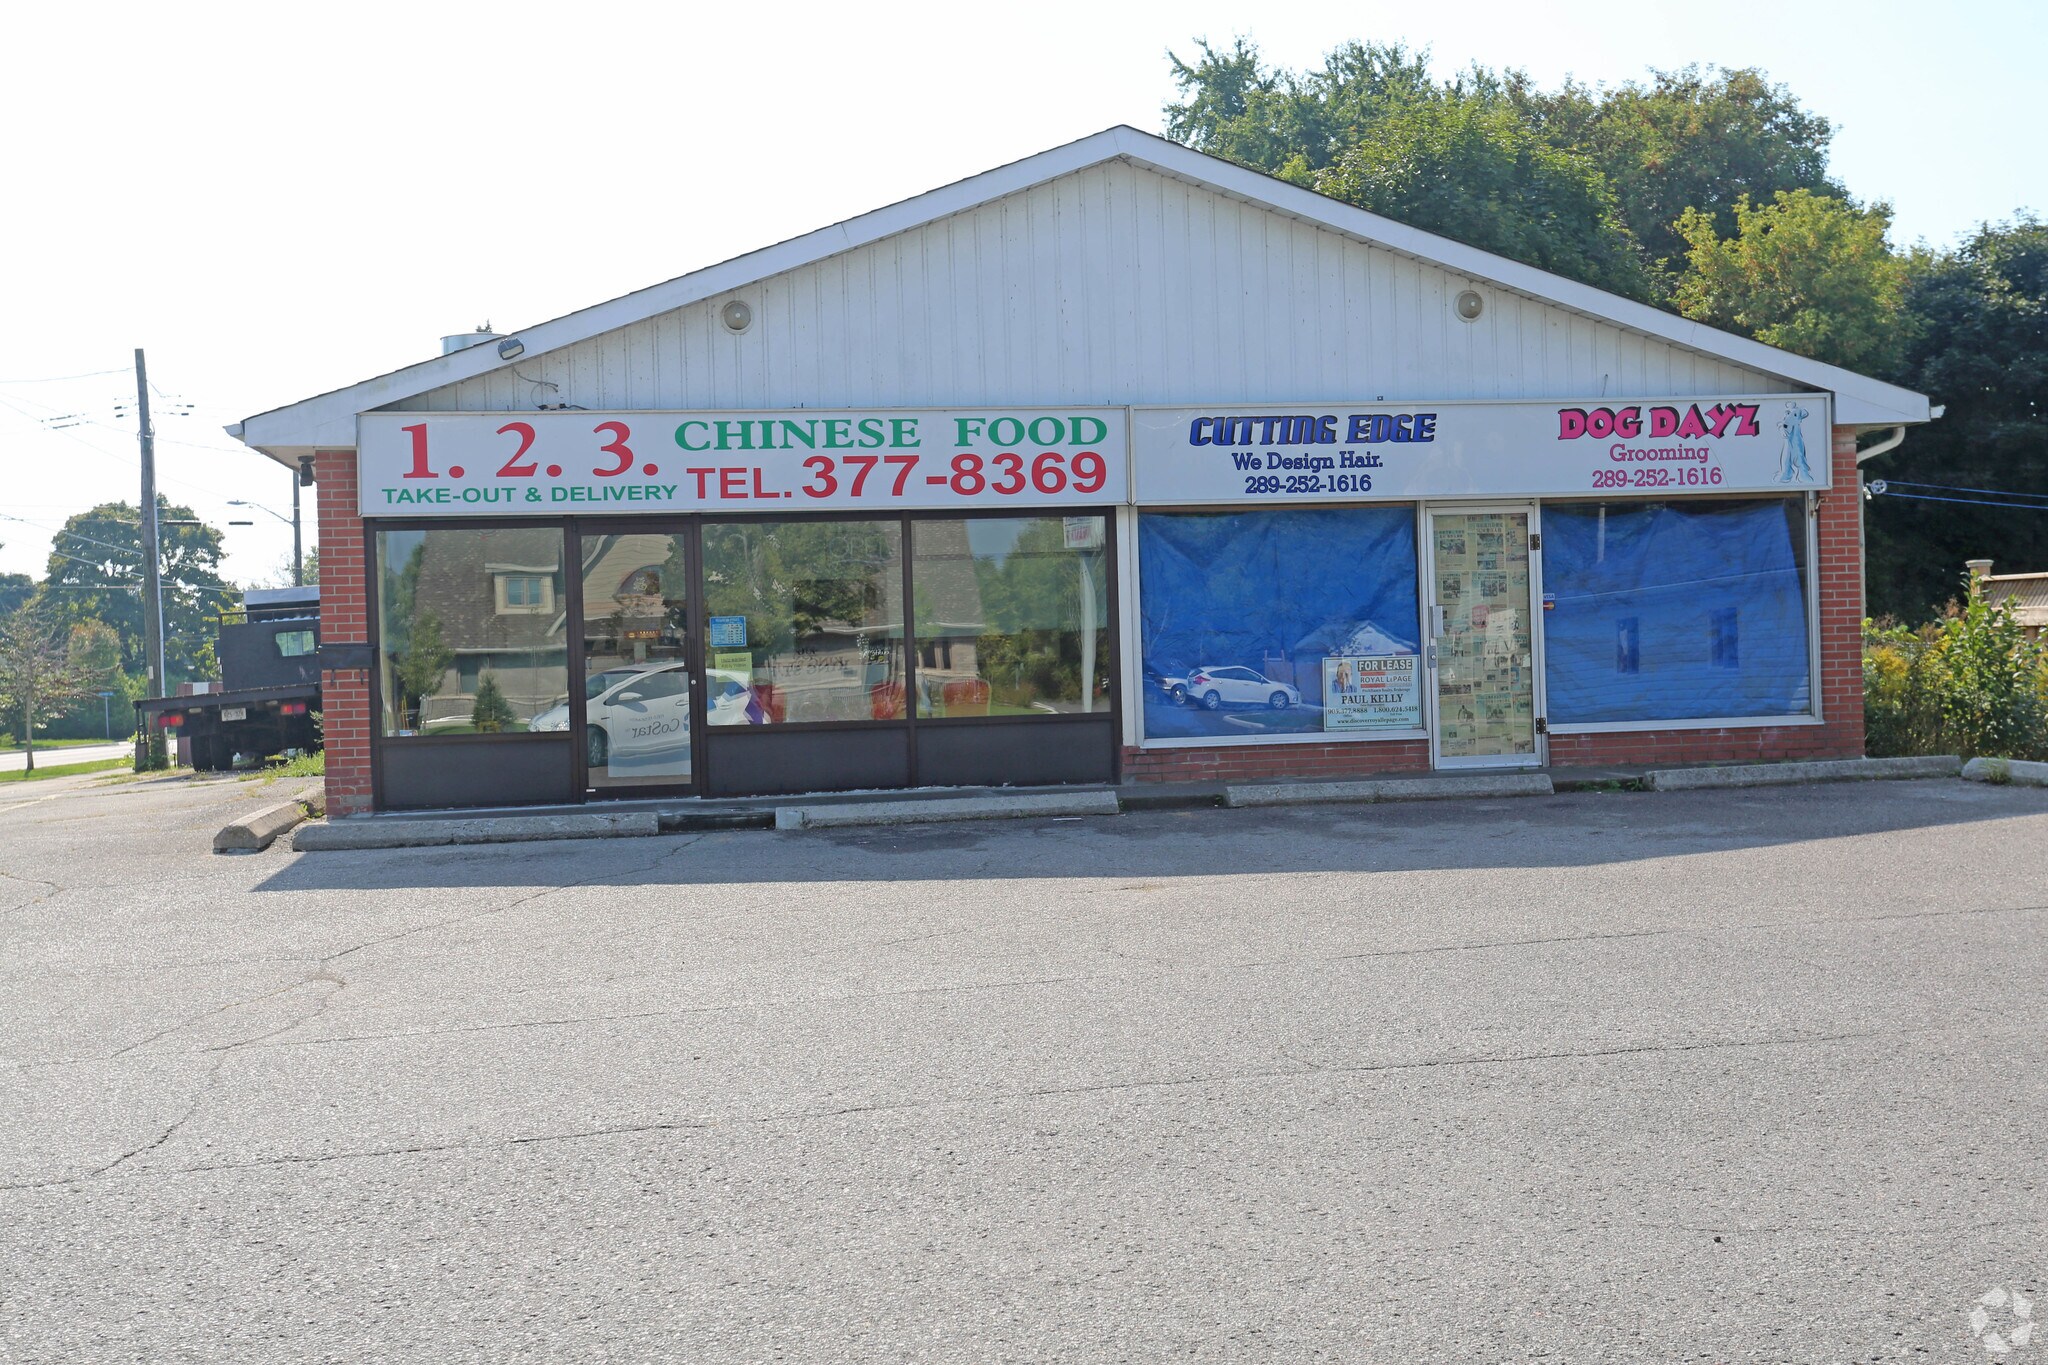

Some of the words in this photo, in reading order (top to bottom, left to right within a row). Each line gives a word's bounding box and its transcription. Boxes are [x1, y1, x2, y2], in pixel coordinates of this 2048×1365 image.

[674, 418, 921, 451] CHINESE
[953, 416, 1108, 447] FOOD
[1189, 415, 1337, 446] CUTTING
[1345, 413, 1437, 444] EDGE
[1558, 406, 1643, 440] DOG
[1232, 452, 1262, 470] We
[1267, 451, 1334, 473] Design
[1339, 450, 1383, 469] Hair.
[1609, 444, 1709, 463] Grooming
[801, 452, 1106, 498] 377-8369
[1245, 474, 1372, 494] 289-252-1616
[1592, 466, 1722, 488] 289-252-1616
[382, 487, 516, 504] TAKE-OUT
[525, 486, 542, 503] &
[551, 484, 677, 502] DELIVERY
[1359, 661, 1378, 671] FOR
[1381, 659, 1412, 670] LEASE
[1341, 695, 1368, 704] PAUL
[1371, 694, 1403, 703] KELLY
